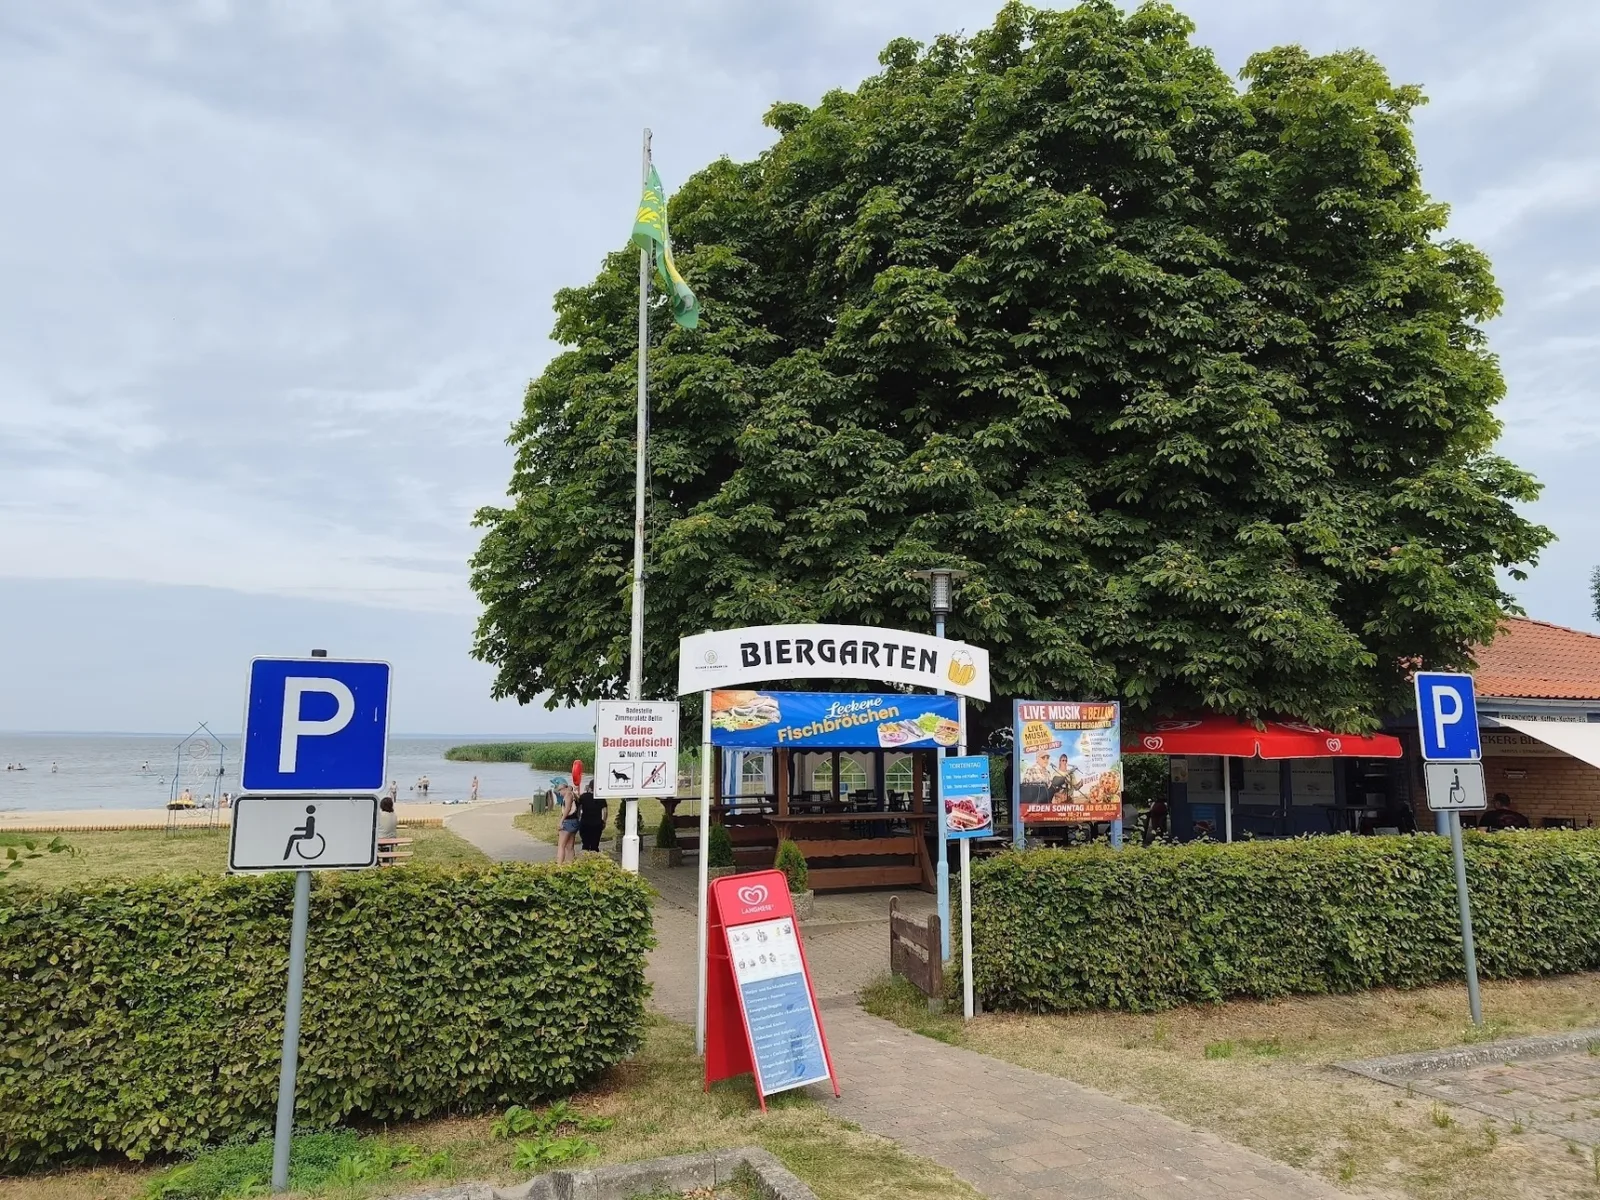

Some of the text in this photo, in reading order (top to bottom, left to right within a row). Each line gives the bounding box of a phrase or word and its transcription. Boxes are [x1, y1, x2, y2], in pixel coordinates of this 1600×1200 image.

[740, 638, 938, 674] BIERGARTEN
[825, 697, 883, 720] Leckere
[1023, 705, 1046, 720] LIVE
[1049, 705, 1081, 720] MUSIK
[614, 714, 647, 722] Zimmerplatz
[1431, 685, 1463, 749] P
[278, 676, 355, 773] P
[777, 705, 900, 743] Fischbrötchen
[1027, 724, 1043, 733] LIVE
[624, 725, 653, 735] Keine
[1024, 731, 1048, 740] MUSIK
[1480, 736, 1542, 745] CKERs BIE
[602, 737, 673, 748] Badeaufsicht!
[627, 750, 658, 758] Notruf: 112
[1052, 804, 1084, 812] SONNTAG
[741, 904, 772, 914] LANGNESE
